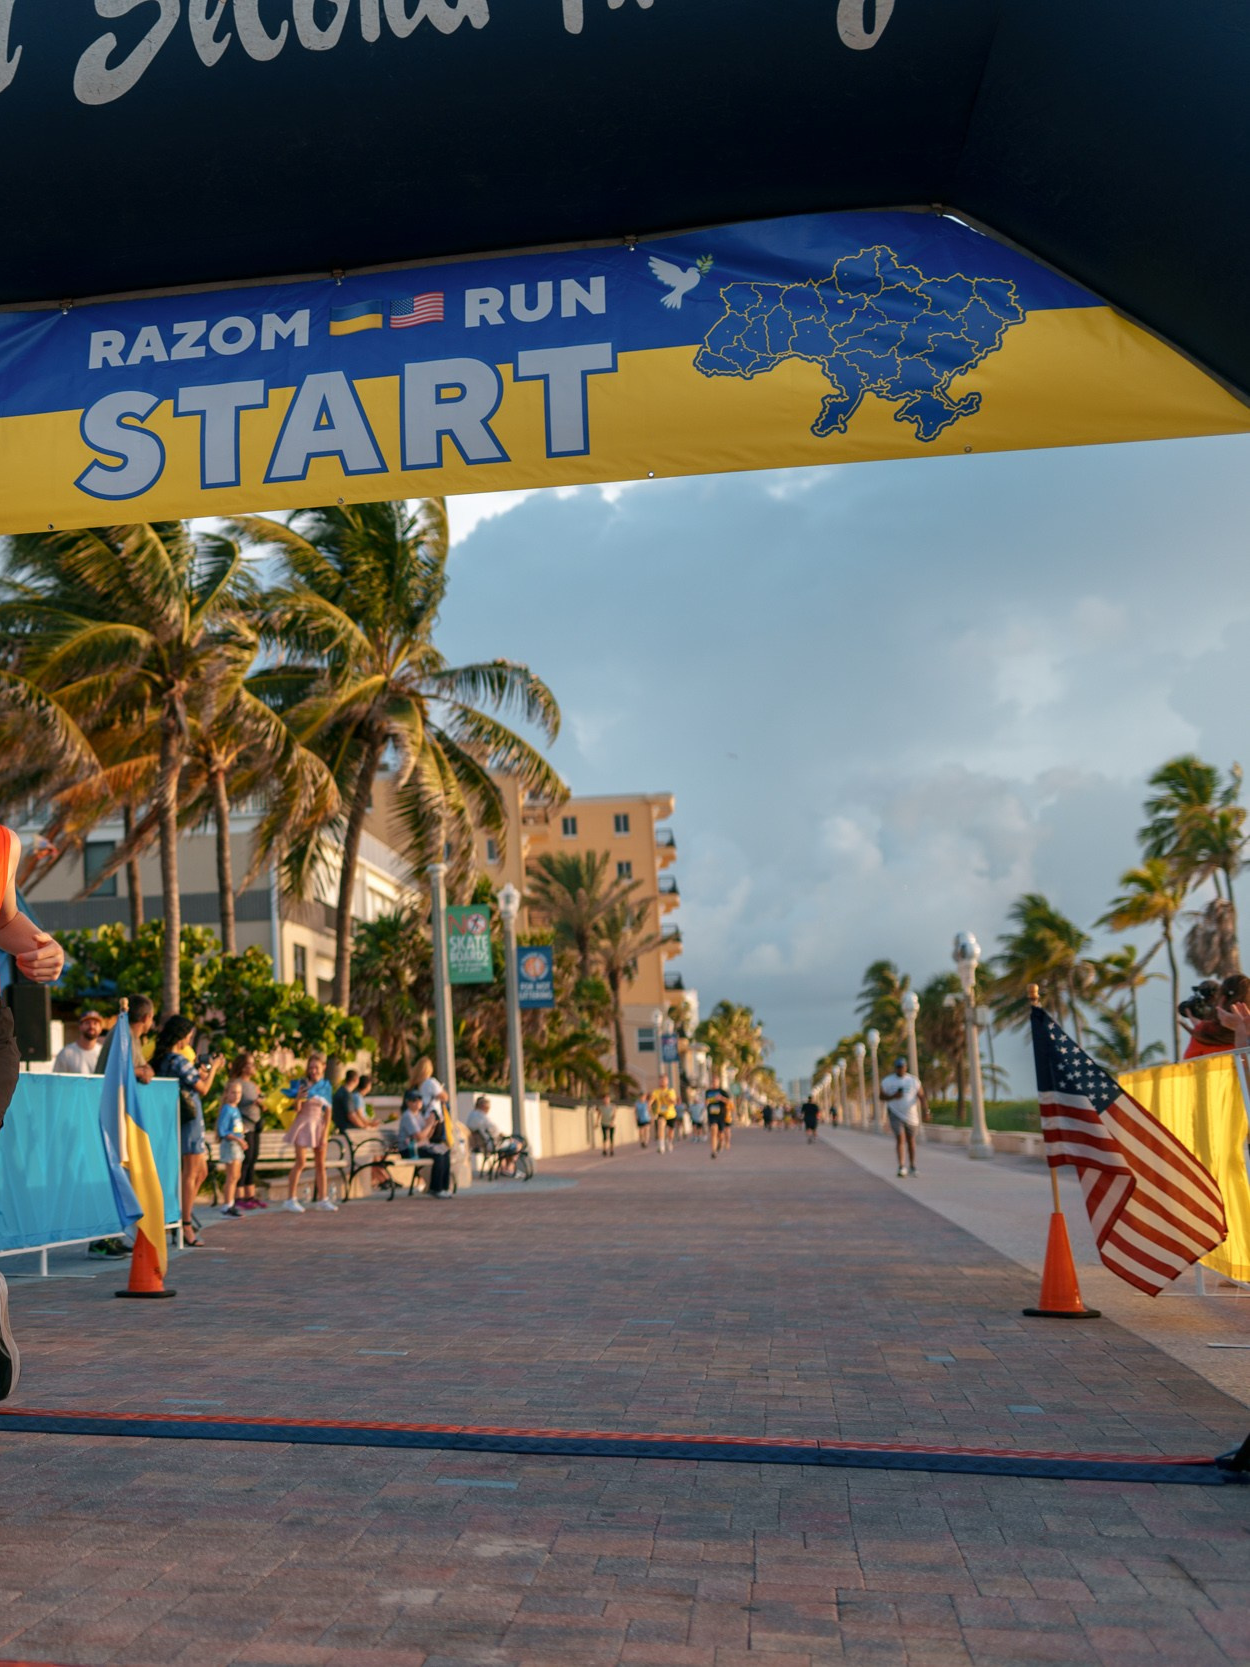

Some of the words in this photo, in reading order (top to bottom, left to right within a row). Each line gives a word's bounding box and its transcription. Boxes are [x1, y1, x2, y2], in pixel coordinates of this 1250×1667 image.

[88, 309, 310, 369] RAZOM
[465, 276, 606, 328] RUN
[73, 342, 619, 501] START
[449, 935, 488, 950] SKATE
